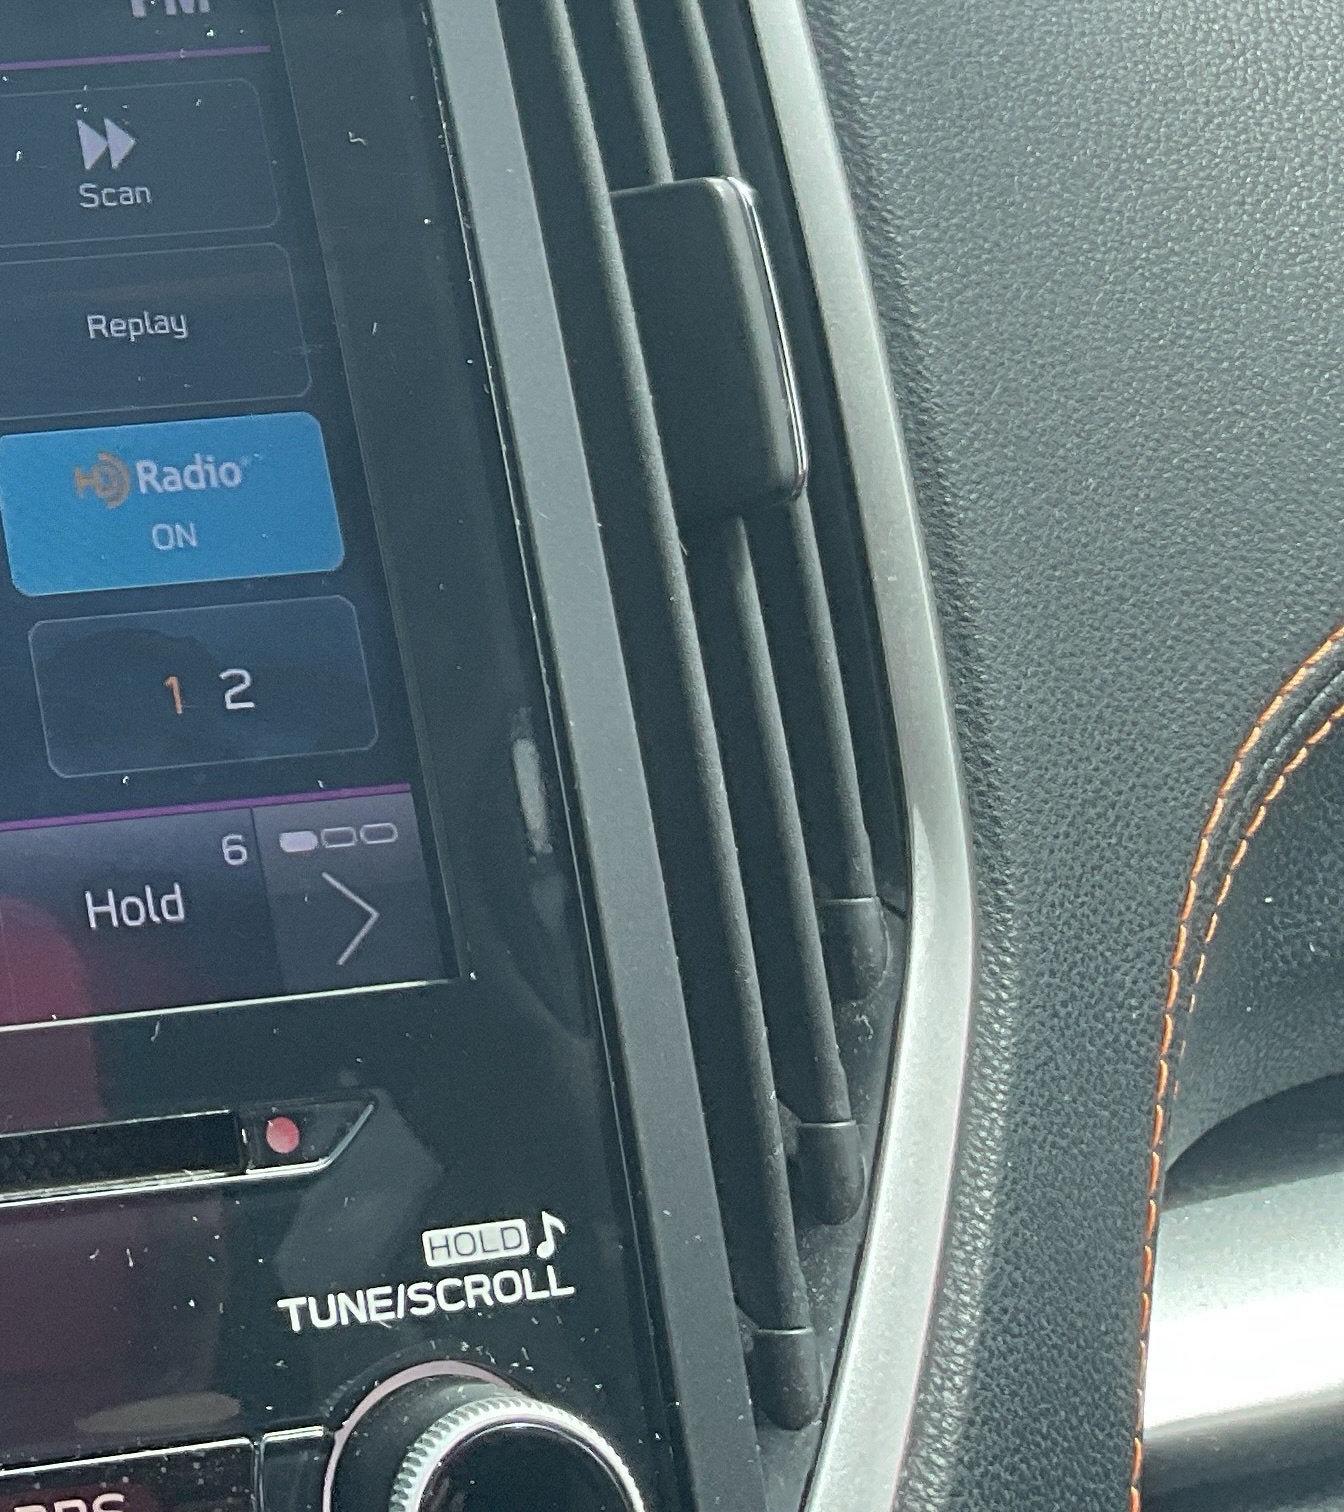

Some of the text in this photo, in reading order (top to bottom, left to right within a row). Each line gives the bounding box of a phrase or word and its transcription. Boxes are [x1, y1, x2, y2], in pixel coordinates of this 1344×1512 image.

[79, 183, 152, 209] Scan
[87, 311, 189, 343] Replay
[136, 453, 244, 495] Radio
[151, 522, 199, 551] ON
[164, 668, 255, 714] 1 2
[220, 833, 248, 867] 6
[85, 882, 186, 930] Hold
[428, 1223, 525, 1261] HOLD
[277, 1264, 575, 1334] TUNE/SCROLL
